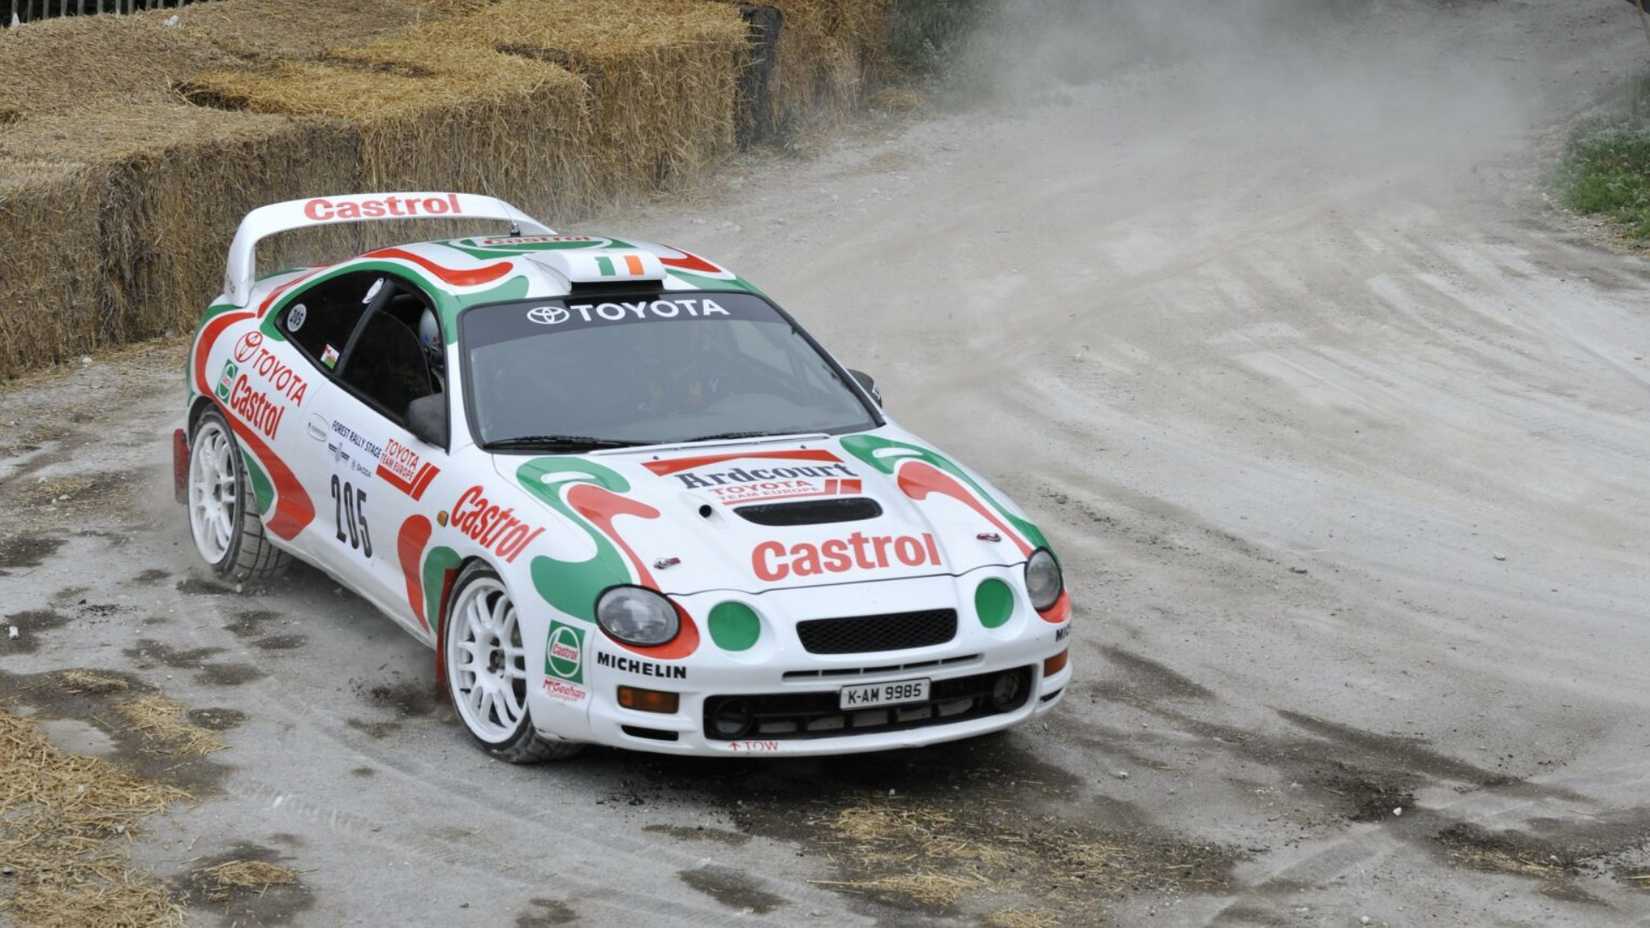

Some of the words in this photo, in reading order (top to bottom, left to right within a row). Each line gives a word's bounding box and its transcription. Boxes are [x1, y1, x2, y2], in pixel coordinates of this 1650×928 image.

[303, 193, 461, 221] Castrol
[569, 298, 731, 322] TOYOTA
[252, 348, 308, 408] TOYOTA
[230, 374, 285, 441] Castrol
[331, 419, 351, 439] FOREST
[348, 430, 365, 449] RALLY
[380, 452, 395, 470] TEAM
[393, 462, 415, 481] EUROPE
[384, 438, 420, 471] TOYOTA
[674, 463, 859, 489] Ardcourt
[709, 479, 813, 495] TOYOTA
[720, 490, 761, 500] TEAM
[763, 487, 820, 497] EUROPE
[330, 473, 373, 559] 205
[450, 485, 546, 564] Castrol
[751, 531, 942, 582] Castrol
[597, 651, 686, 679] MICHELIN
[847, 687, 880, 704] K-AM
[884, 683, 923, 701] 9985
